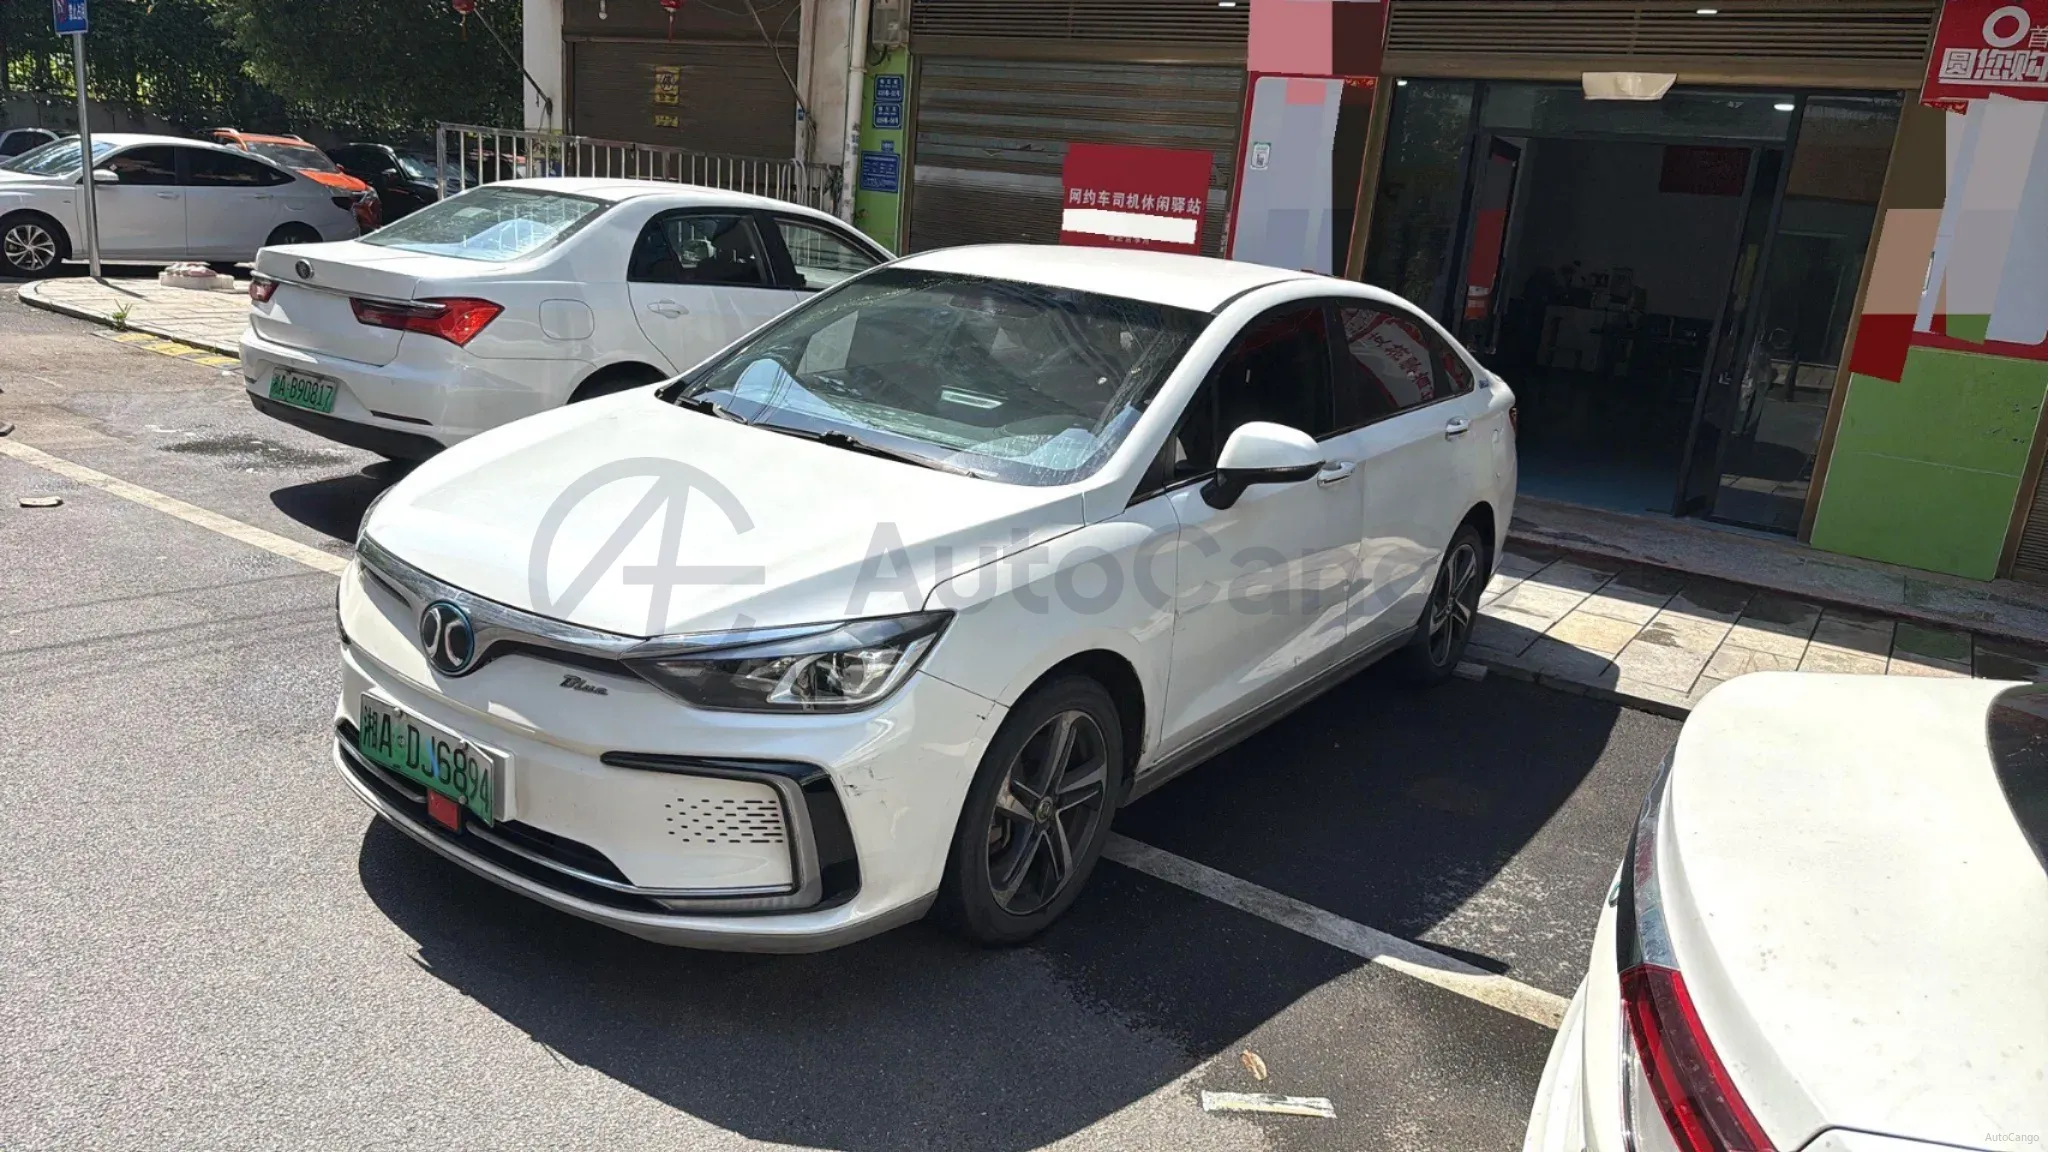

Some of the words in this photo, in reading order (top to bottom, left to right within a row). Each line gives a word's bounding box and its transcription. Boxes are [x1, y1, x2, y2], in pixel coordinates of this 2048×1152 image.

[1069, 188, 1202, 215] 网约车司机休闲驿站
